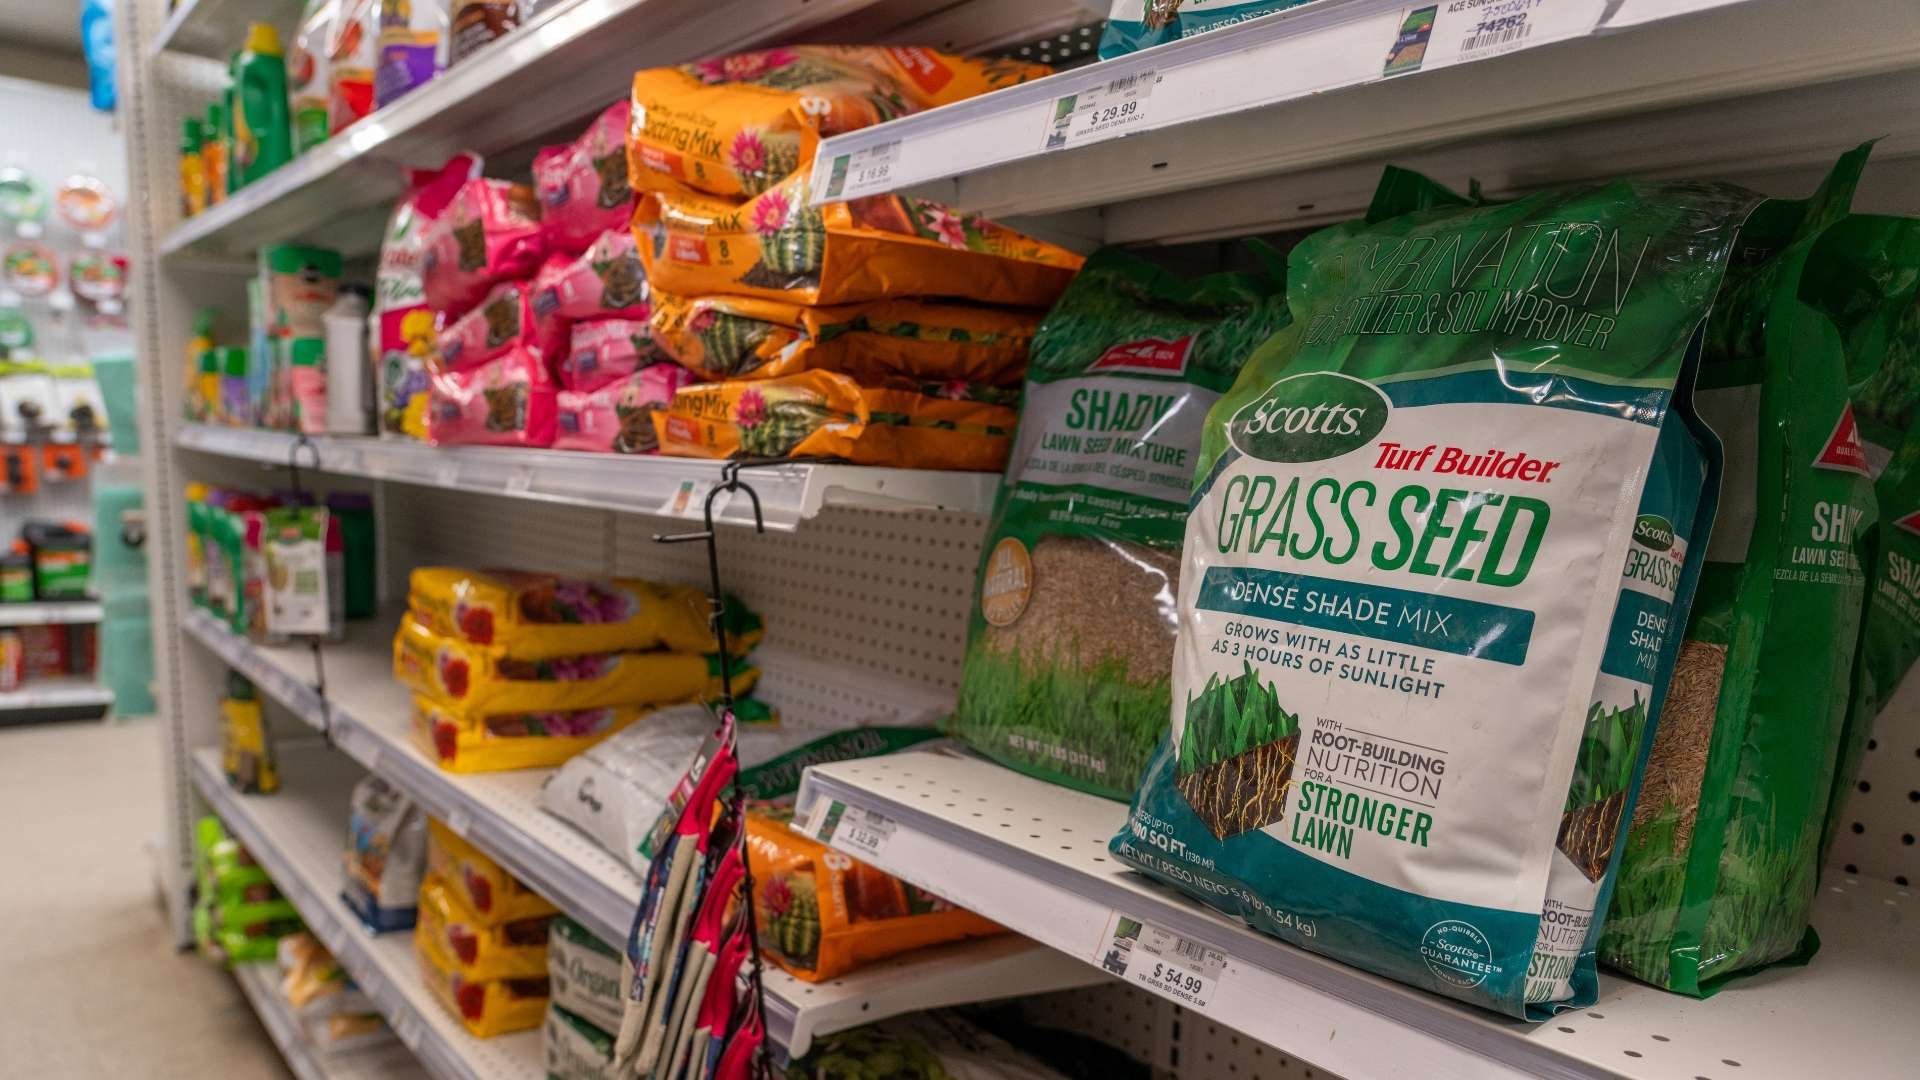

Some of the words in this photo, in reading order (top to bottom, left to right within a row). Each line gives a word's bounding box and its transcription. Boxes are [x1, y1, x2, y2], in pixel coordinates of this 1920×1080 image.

[1448, 3, 1465, 13] ACE
[1091, 111, 1099, 125] $
[1101, 101, 1137, 122] 29.99
[719, 240, 729, 258] 8
[1335, 223, 1650, 316] MBINATION
[1417, 295, 1438, 335] &
[1439, 290, 1489, 334] SOIL
[1486, 288, 1617, 349] IMPROVER
[1066, 388, 1177, 437] SHADY
[1243, 397, 1365, 436] Scotts
[1041, 432, 1082, 454] LAWN
[1083, 437, 1112, 454] SEED
[1112, 438, 1188, 468] MIXTURE
[1374, 442, 1436, 471] Turf
[1434, 446, 1560, 483] Builder
[1218, 475, 1377, 565] GRASS
[1371, 484, 1550, 588] SEED
[1635, 521, 1672, 545] Scotts
[1623, 549, 1670, 588] GRASS
[1792, 546, 1826, 565] LAWN
[1799, 571, 1809, 583] DE
[1810, 572, 1820, 583] LA
[1233, 581, 1299, 610] DENSE
[1303, 592, 1391, 625] SHADE
[1397, 606, 1453, 637] MIX
[1225, 622, 1279, 644] GROWS
[1285, 634, 1330, 654] WITH
[1336, 643, 1360, 660] AS
[1367, 650, 1436, 676] LITTLE
[1212, 639, 1228, 653] AS
[1232, 643, 1240, 656] 3
[1244, 645, 1303, 669] HOURS
[1309, 658, 1335, 676] OF
[1339, 666, 1445, 699] SUNLIGHT
[1008, 735, 1024, 748] NET
[1316, 717, 1343, 731] WITH
[1311, 729, 1446, 775] ROOT-BUILDING
[1304, 768, 1324, 782] FOR
[1324, 774, 1332, 784] A
[1306, 746, 1441, 800] NUTRITION
[1151, 817, 1162, 829] UP
[1162, 822, 1174, 835] TO
[1298, 781, 1433, 848] STRONGER
[1149, 829, 1168, 851] SQ
[1170, 838, 1187, 857] FT
[1185, 849, 1200, 864] (130
[1292, 812, 1354, 860] LAWN
[1119, 840, 1136, 858] NET
[1136, 849, 1153, 867] WT
[1162, 861, 1192, 882] PESO
[1193, 875, 1230, 896] NETO
[1230, 887, 1250, 903] 5.6
[1295, 915, 1318, 938] kg)
[1436, 939, 1475, 958] Scotts
[1437, 926, 1482, 945] NO-QUIBBLE
[1154, 963, 1163, 978] $
[1165, 968, 1202, 994] 54.99
[1173, 988, 1193, 1002] DENSE
